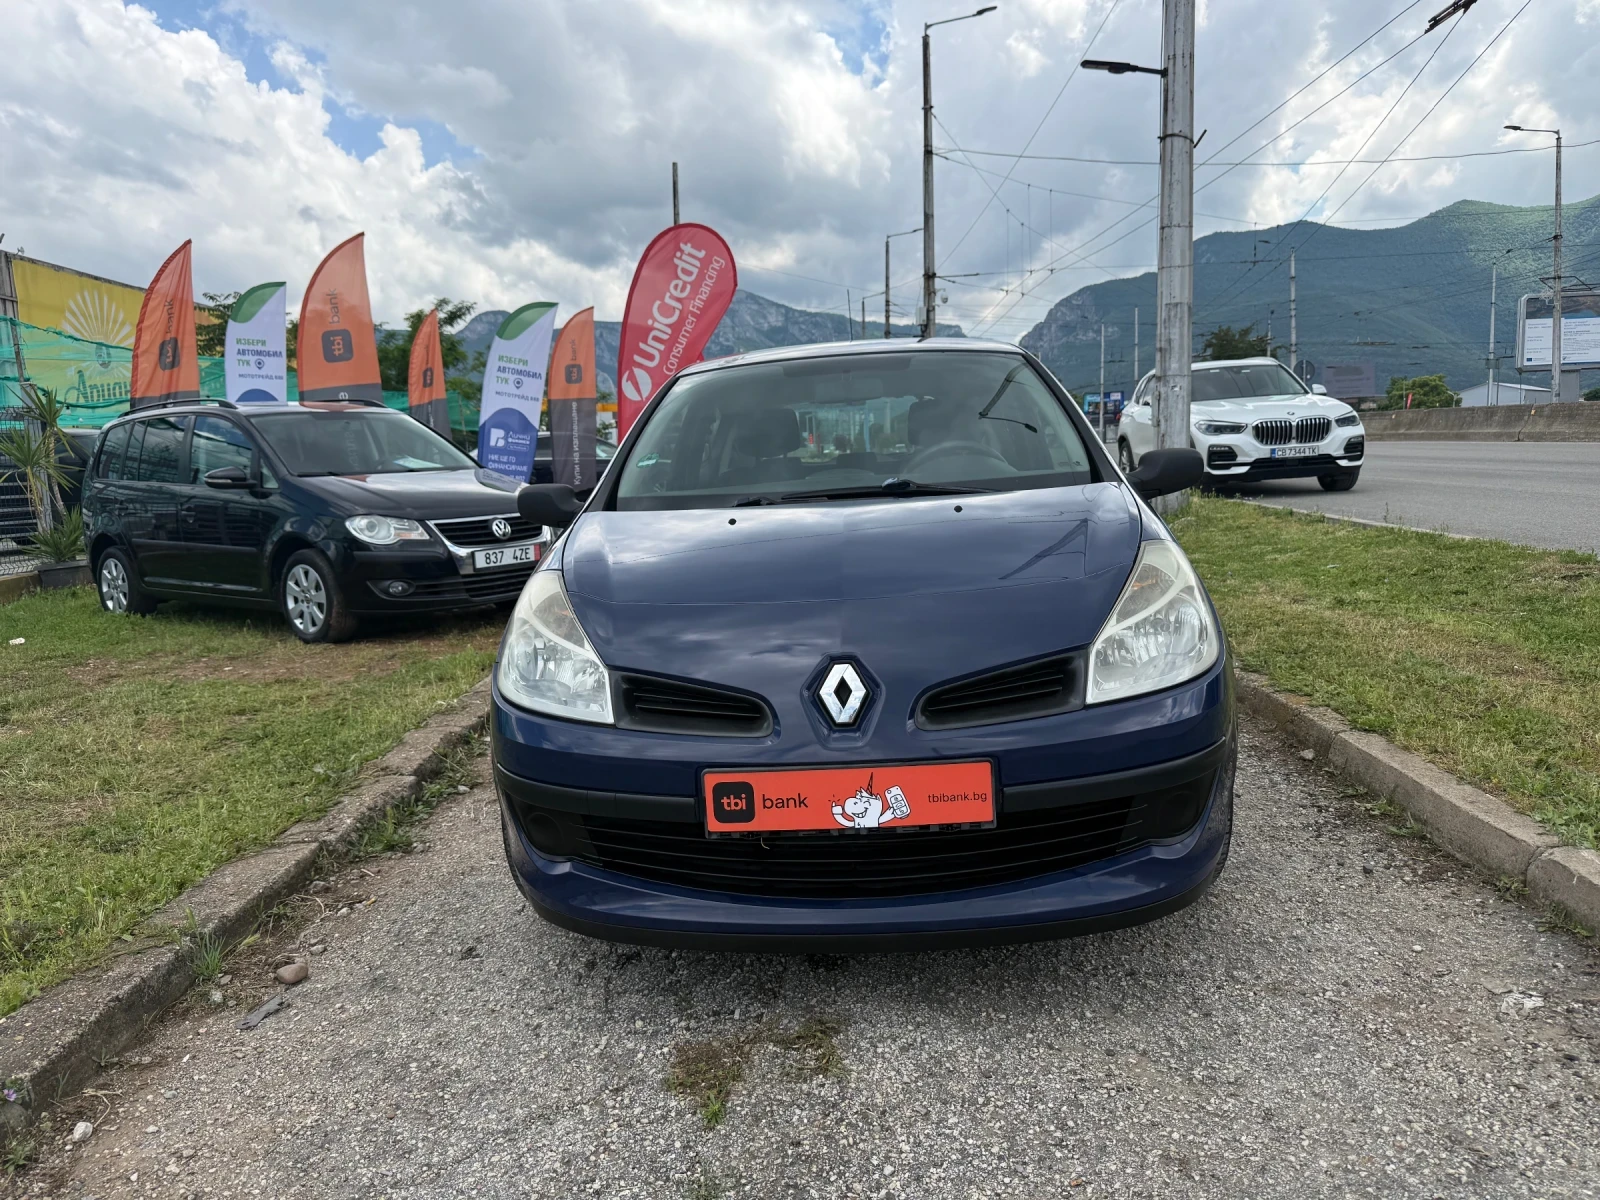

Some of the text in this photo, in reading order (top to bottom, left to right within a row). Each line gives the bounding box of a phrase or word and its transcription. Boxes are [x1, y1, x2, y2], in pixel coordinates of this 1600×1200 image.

[633, 242, 706, 368] UniCredit
[663, 255, 726, 376] Consumer Financing
[326, 288, 344, 357] tbi bank
[236, 338, 267, 347] ИЗБЕРИ
[236, 348, 283, 358] АВТОМОБИЛ
[237, 359, 251, 367] ТУК
[498, 355, 528, 366] ИЗБЕРИ
[496, 365, 542, 380] АВТОМОБИЛ
[495, 376, 510, 385] ТУК
[573, 452, 580, 463] на
[574, 463, 582, 486] Купи
[484, 547, 531, 565] 837 4ZE
[720, 792, 809, 811] tbi bank
[927, 791, 988, 803] tbibank.bg
